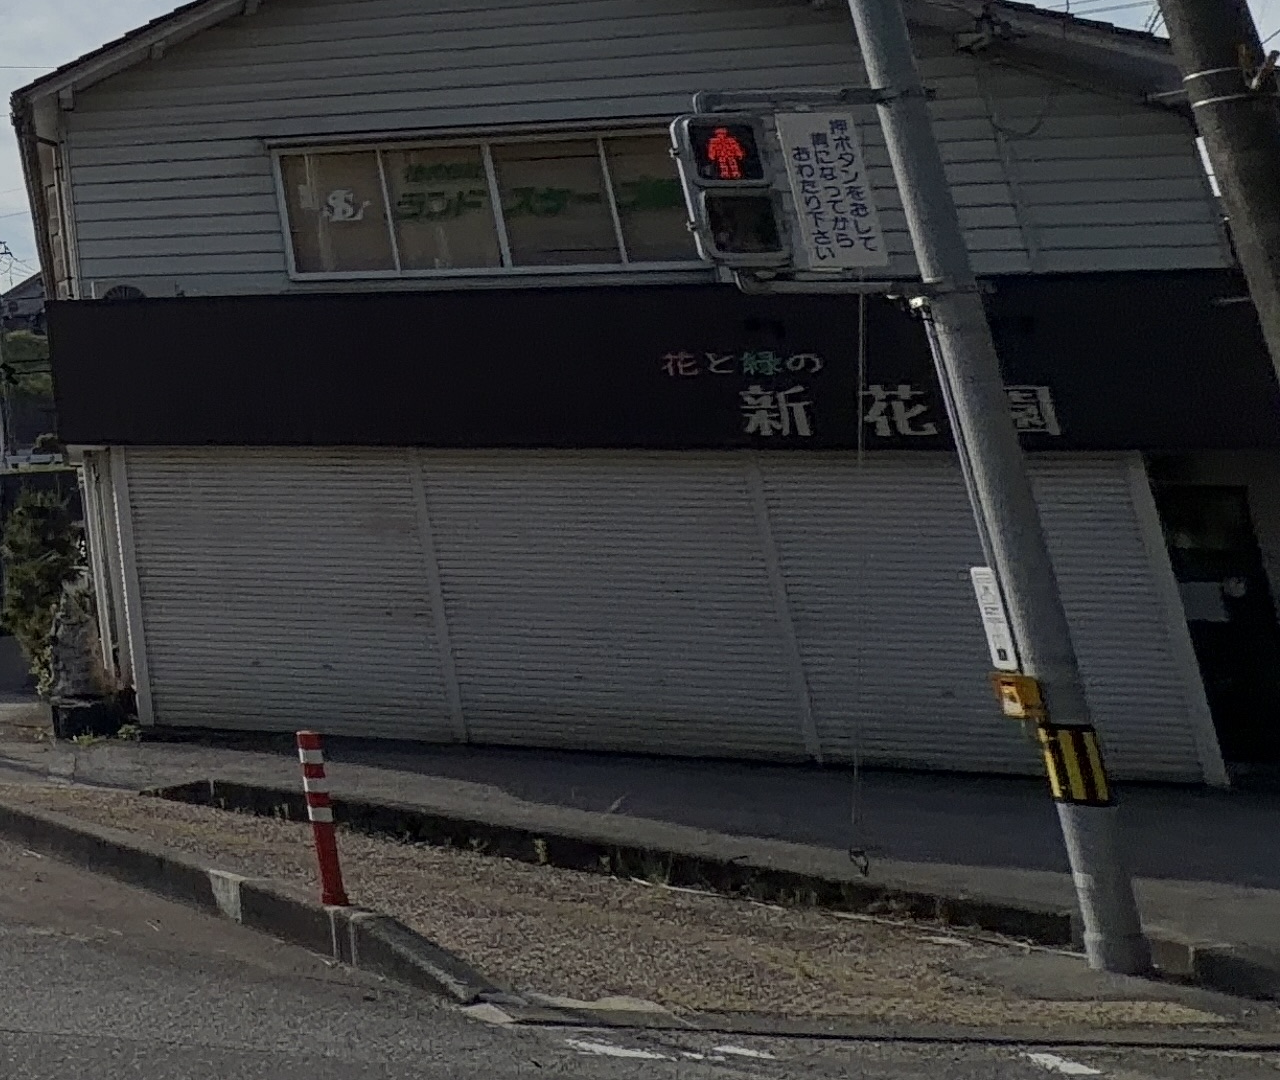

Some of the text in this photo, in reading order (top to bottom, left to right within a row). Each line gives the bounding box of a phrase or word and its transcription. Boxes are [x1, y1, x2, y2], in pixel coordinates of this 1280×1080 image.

[791, 146, 836, 261] おわたり下さい
[829, 119, 878, 252] 押ボタンをおして
[662, 351, 824, 376] 花と緑の
